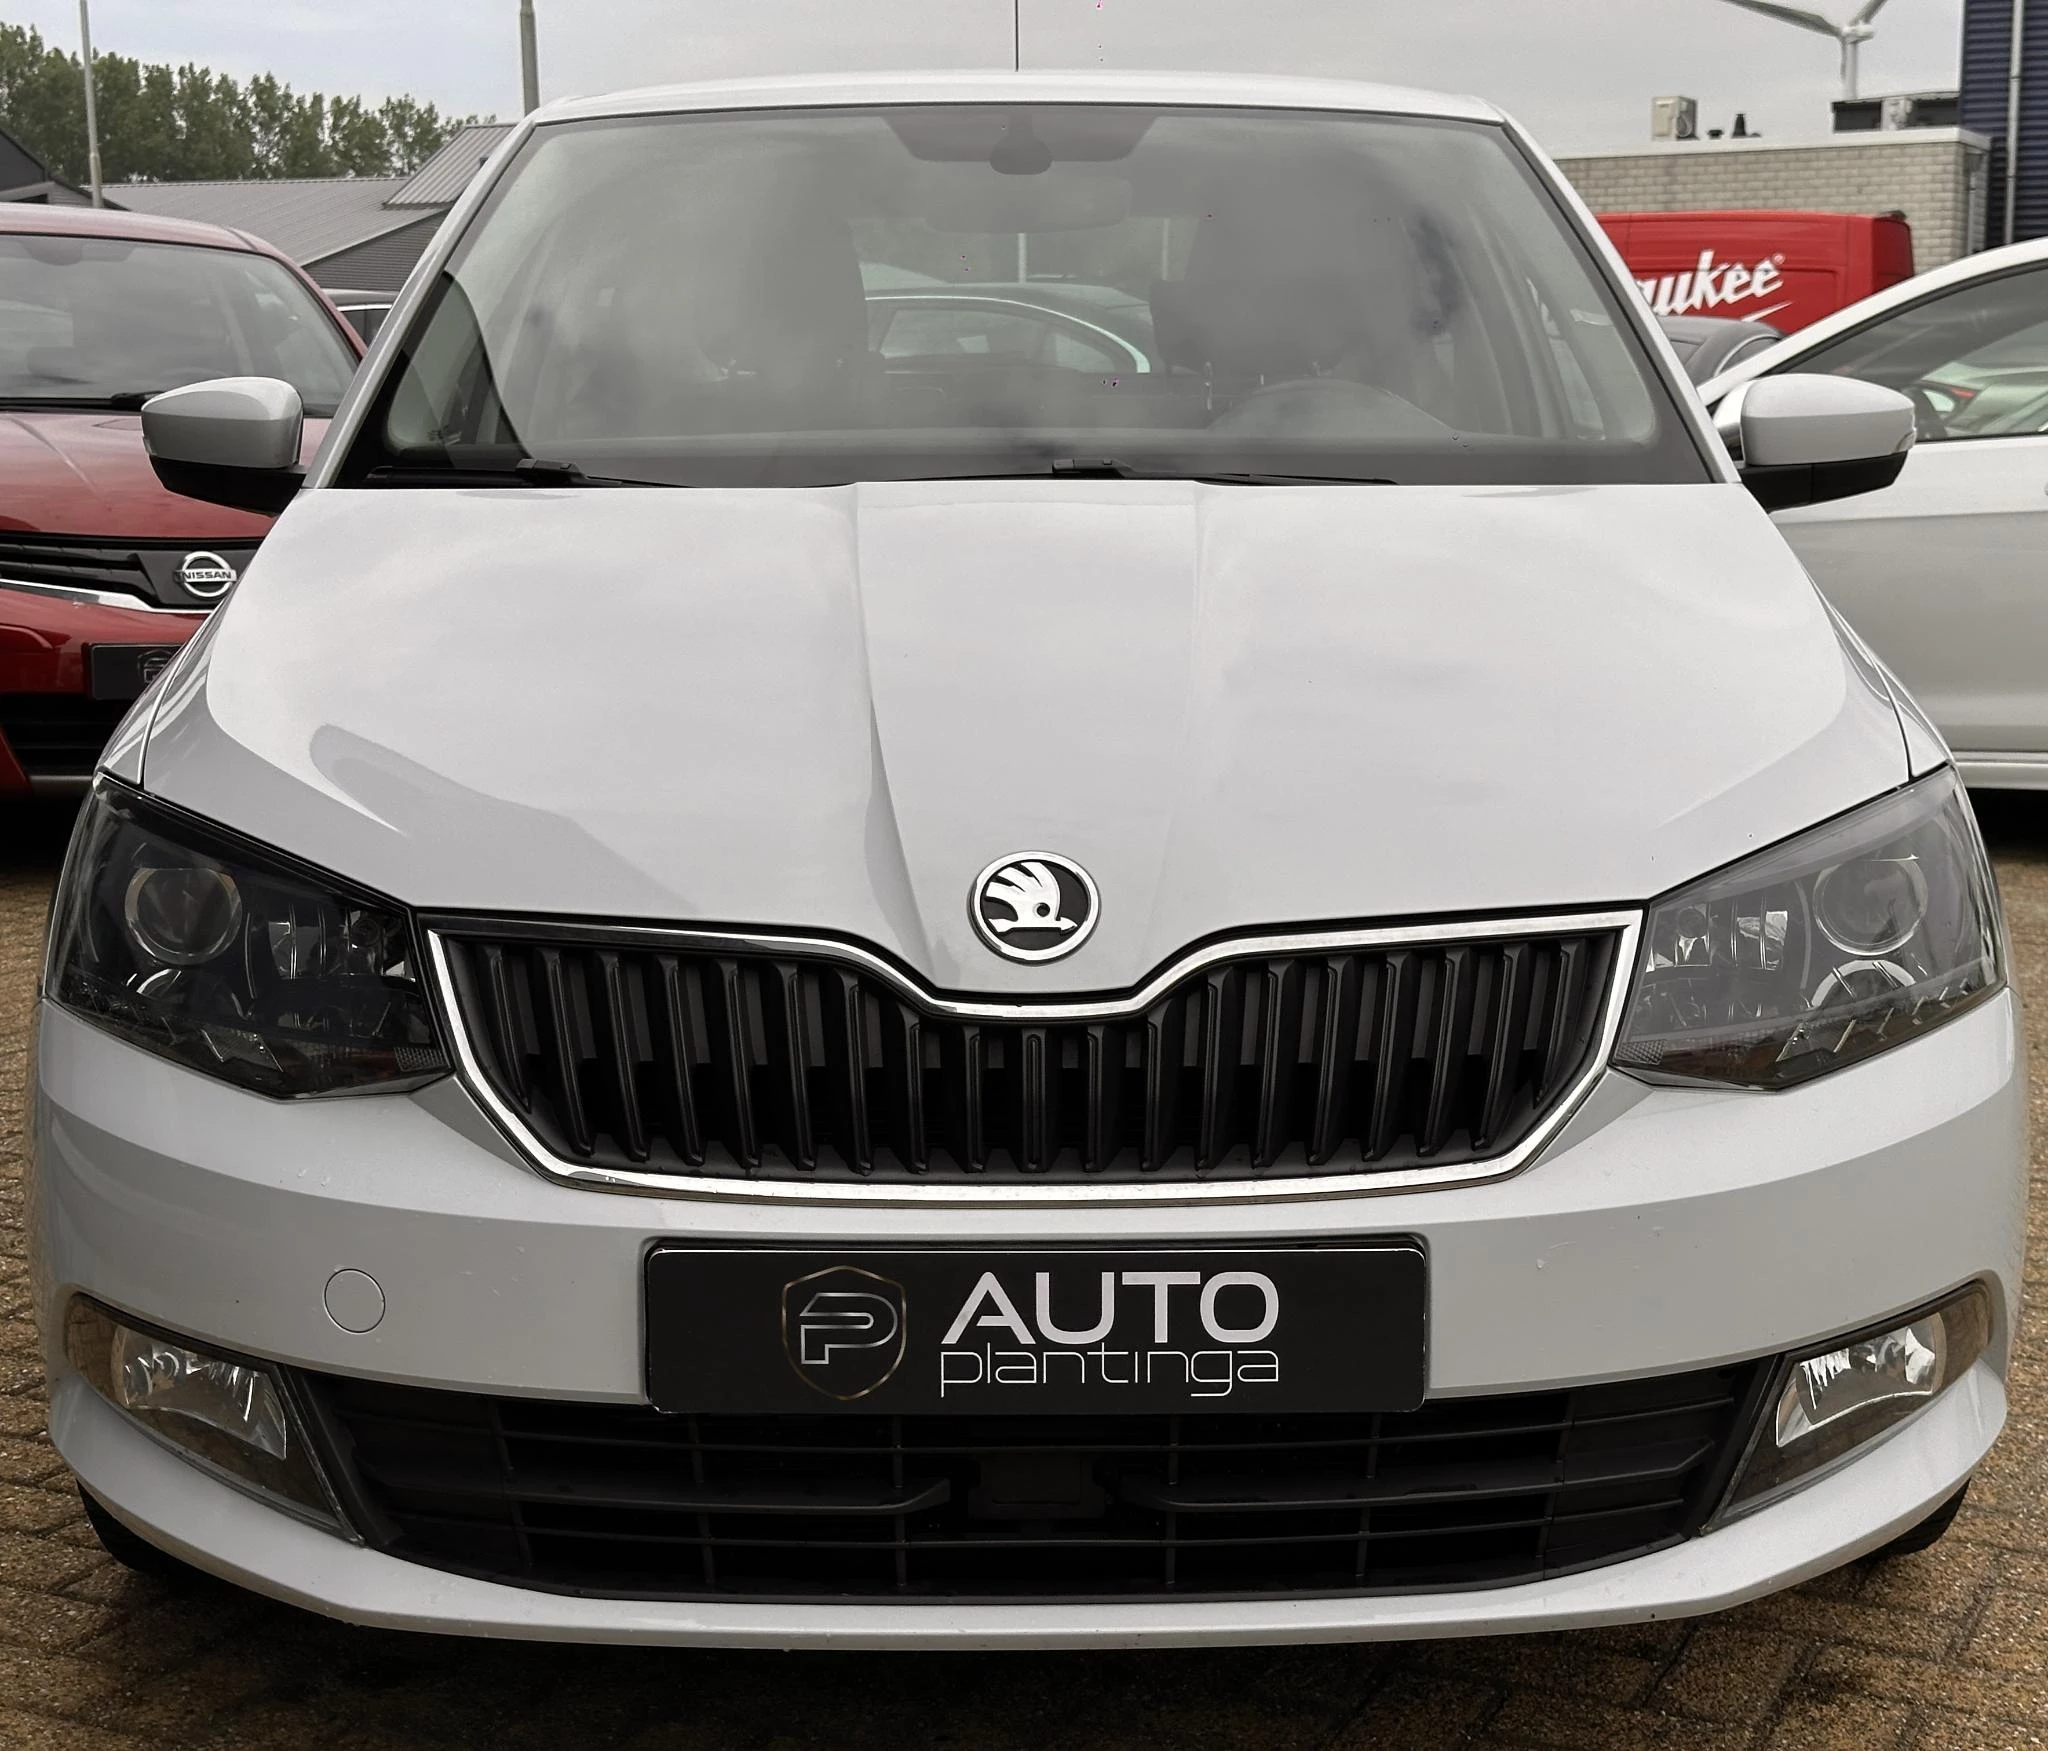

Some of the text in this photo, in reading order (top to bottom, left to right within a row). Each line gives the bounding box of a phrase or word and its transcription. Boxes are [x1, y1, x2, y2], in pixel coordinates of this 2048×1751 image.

[182, 571, 232, 580] NISSAN
[940, 1271, 1280, 1345] AUTO
[940, 1341, 1280, 1399] plantinga
